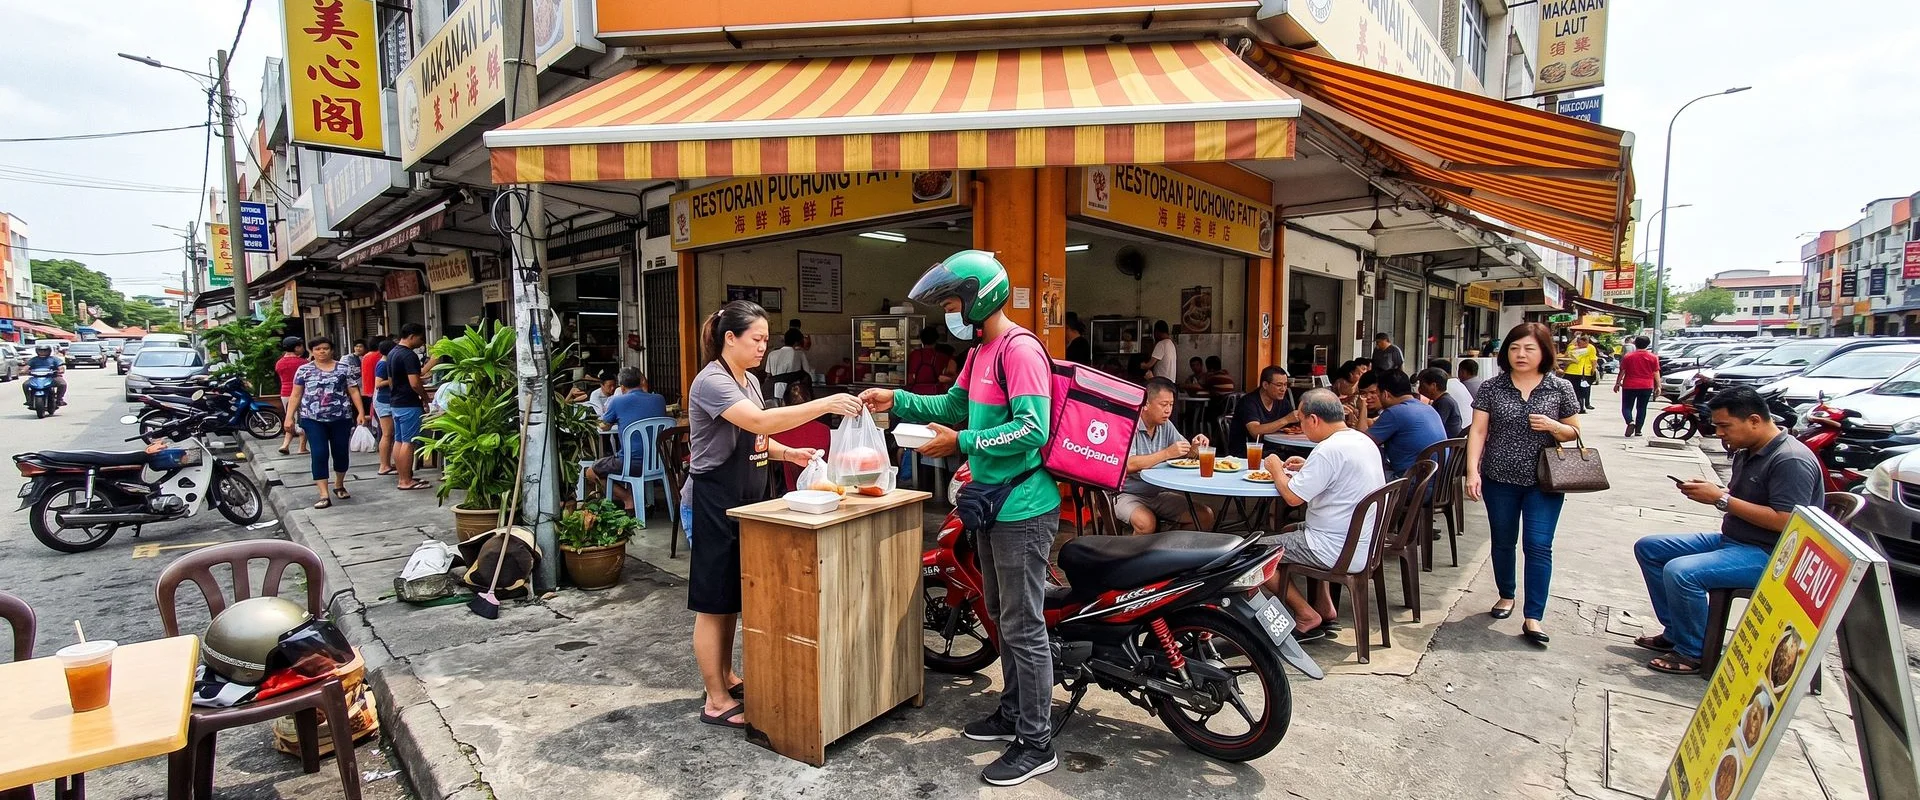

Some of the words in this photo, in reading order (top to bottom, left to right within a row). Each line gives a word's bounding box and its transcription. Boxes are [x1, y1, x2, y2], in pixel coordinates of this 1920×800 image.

[1542, 0, 1604, 20] MAKANAN
[1555, 15, 1588, 38] LAUT
[303, 0, 364, 141] 美心阁
[421, 5, 478, 99] MAKANAN
[480, 0, 503, 43] LA
[1407, 15, 1432, 82] LAUT
[692, 179, 764, 220] RESTORAN
[768, 172, 851, 203] PUCHONG
[734, 194, 845, 235] 海鲜海鲜店
[1115, 164, 1184, 207] RESTORAN
[1186, 184, 1236, 223] PUCHONG
[1237, 201, 1258, 229] FATT
[1062, 437, 1119, 466] foodpanda
[1791, 545, 1838, 609] MENU
